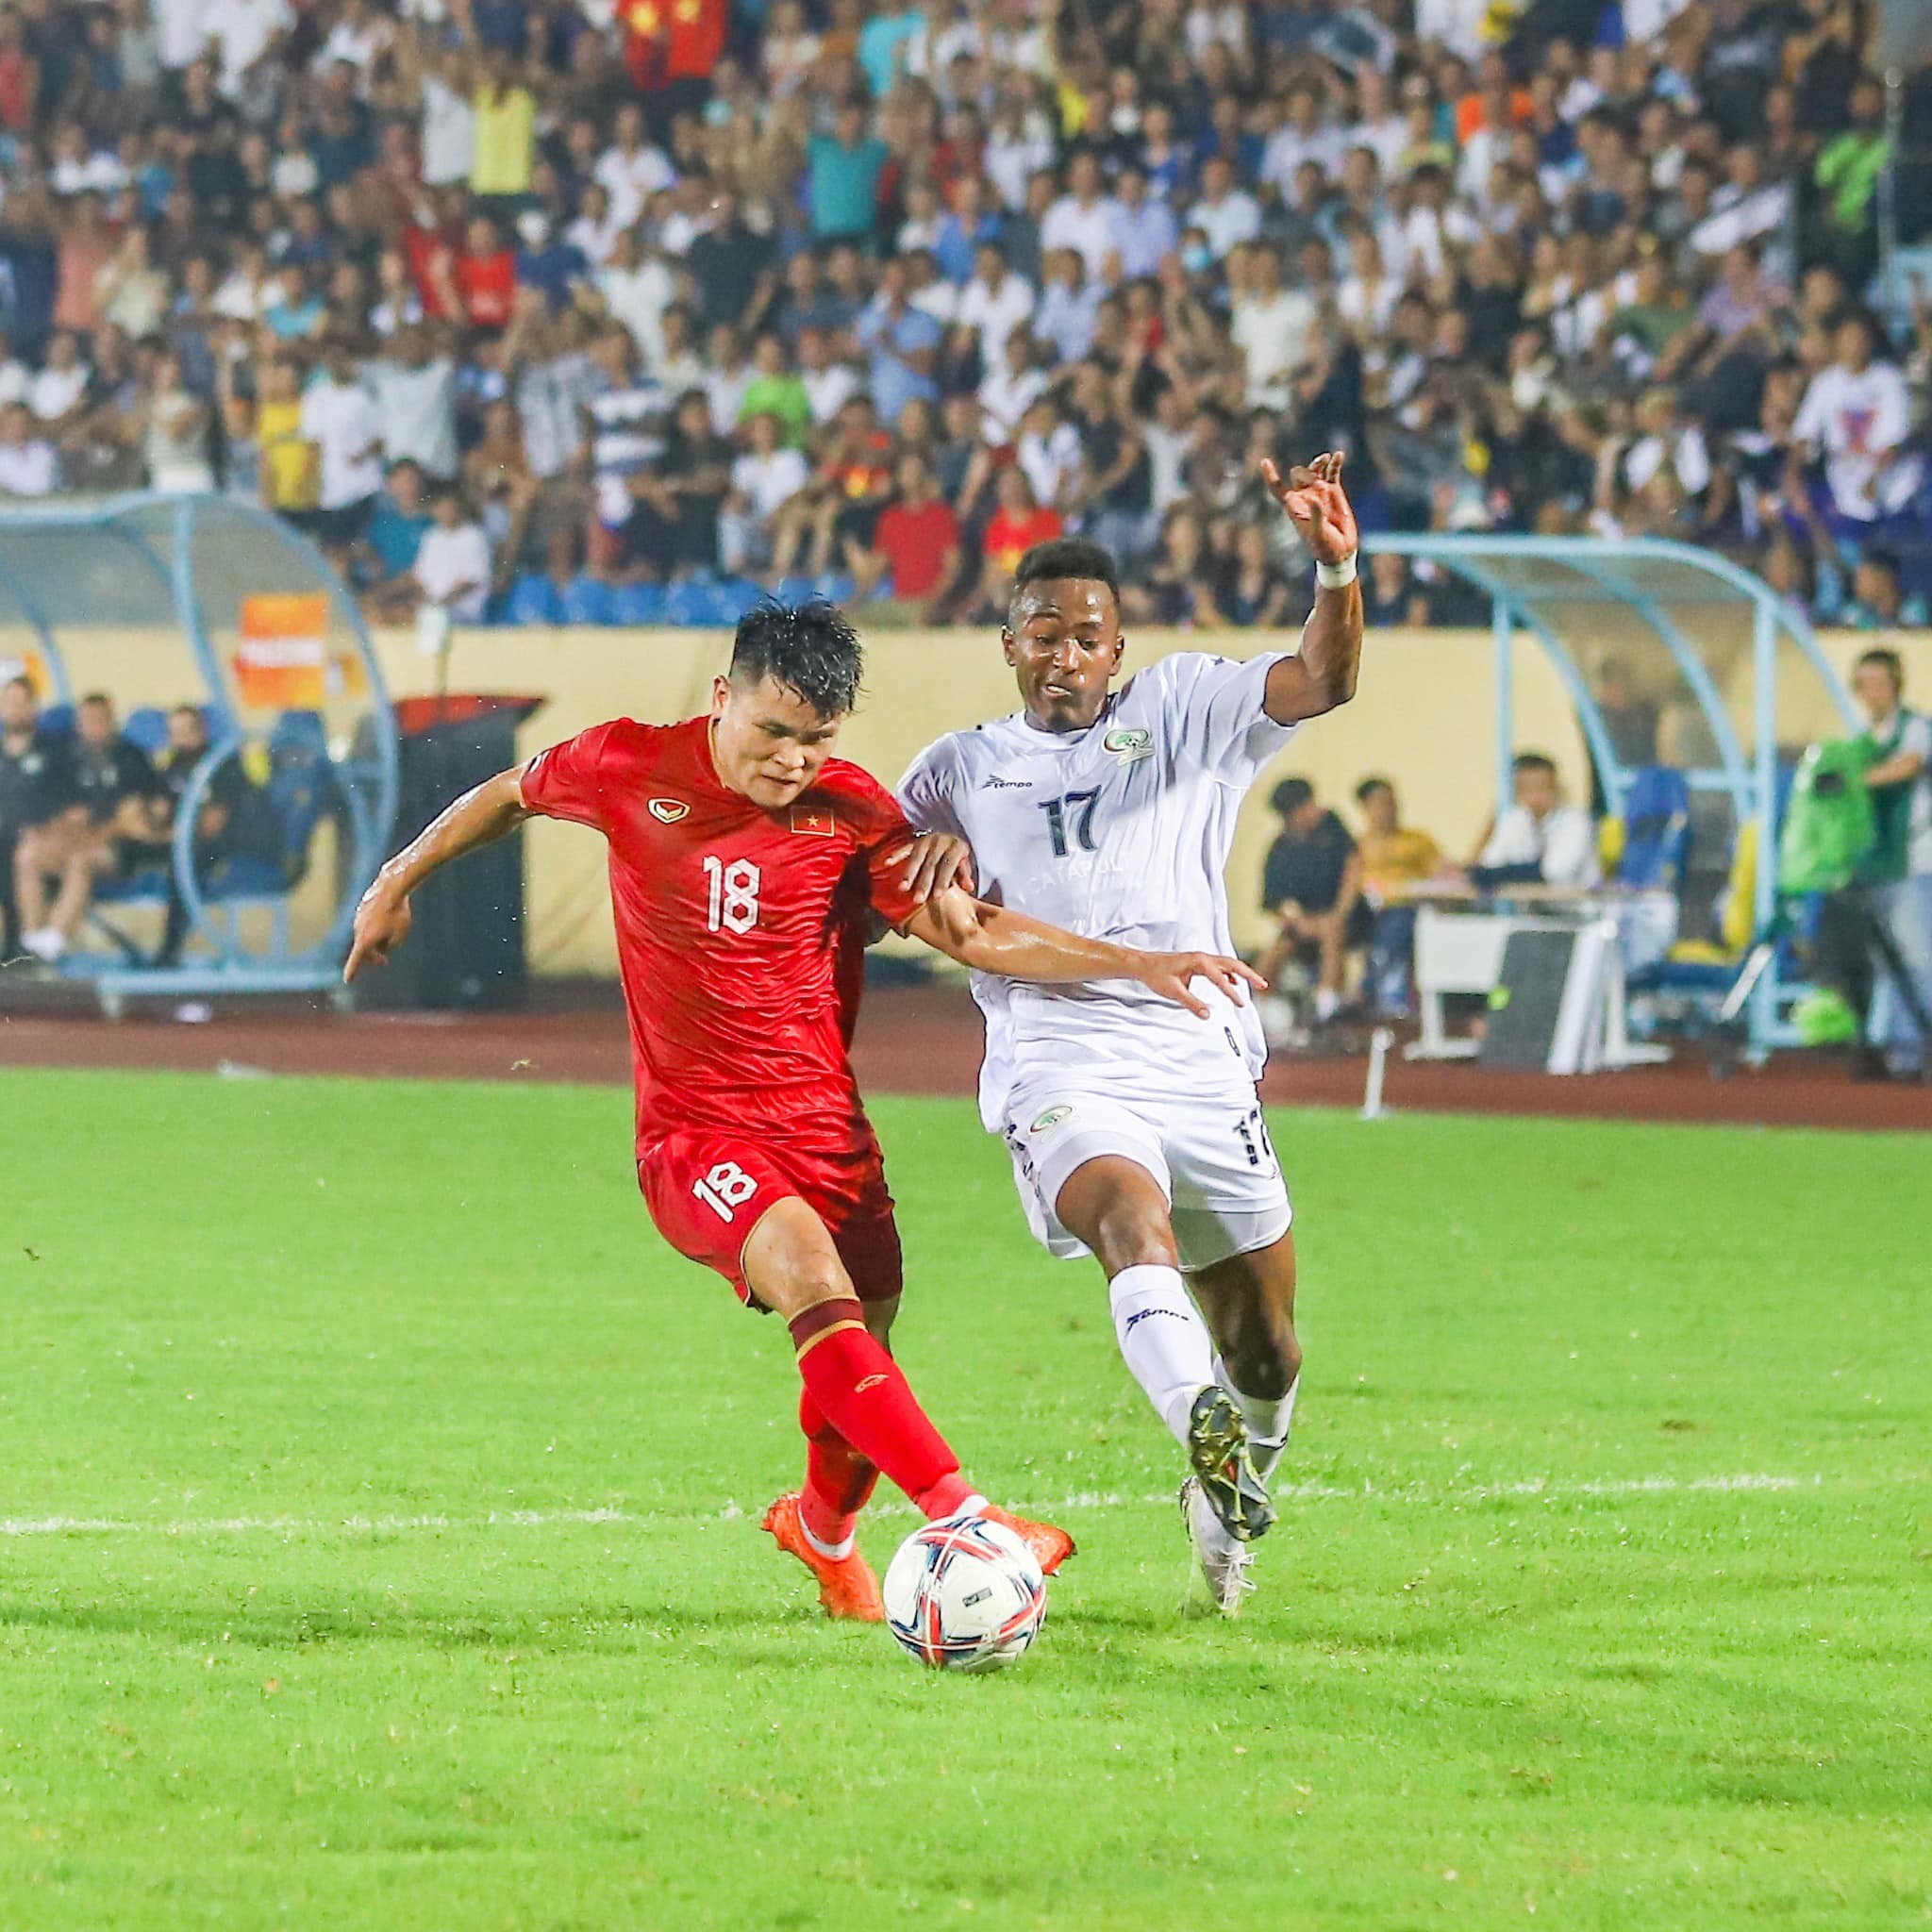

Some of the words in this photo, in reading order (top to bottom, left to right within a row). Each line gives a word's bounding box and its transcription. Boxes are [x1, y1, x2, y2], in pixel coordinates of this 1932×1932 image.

[1038, 785, 1102, 858] 17
[702, 855, 761, 935] 18
[692, 1161, 758, 1223] 18
